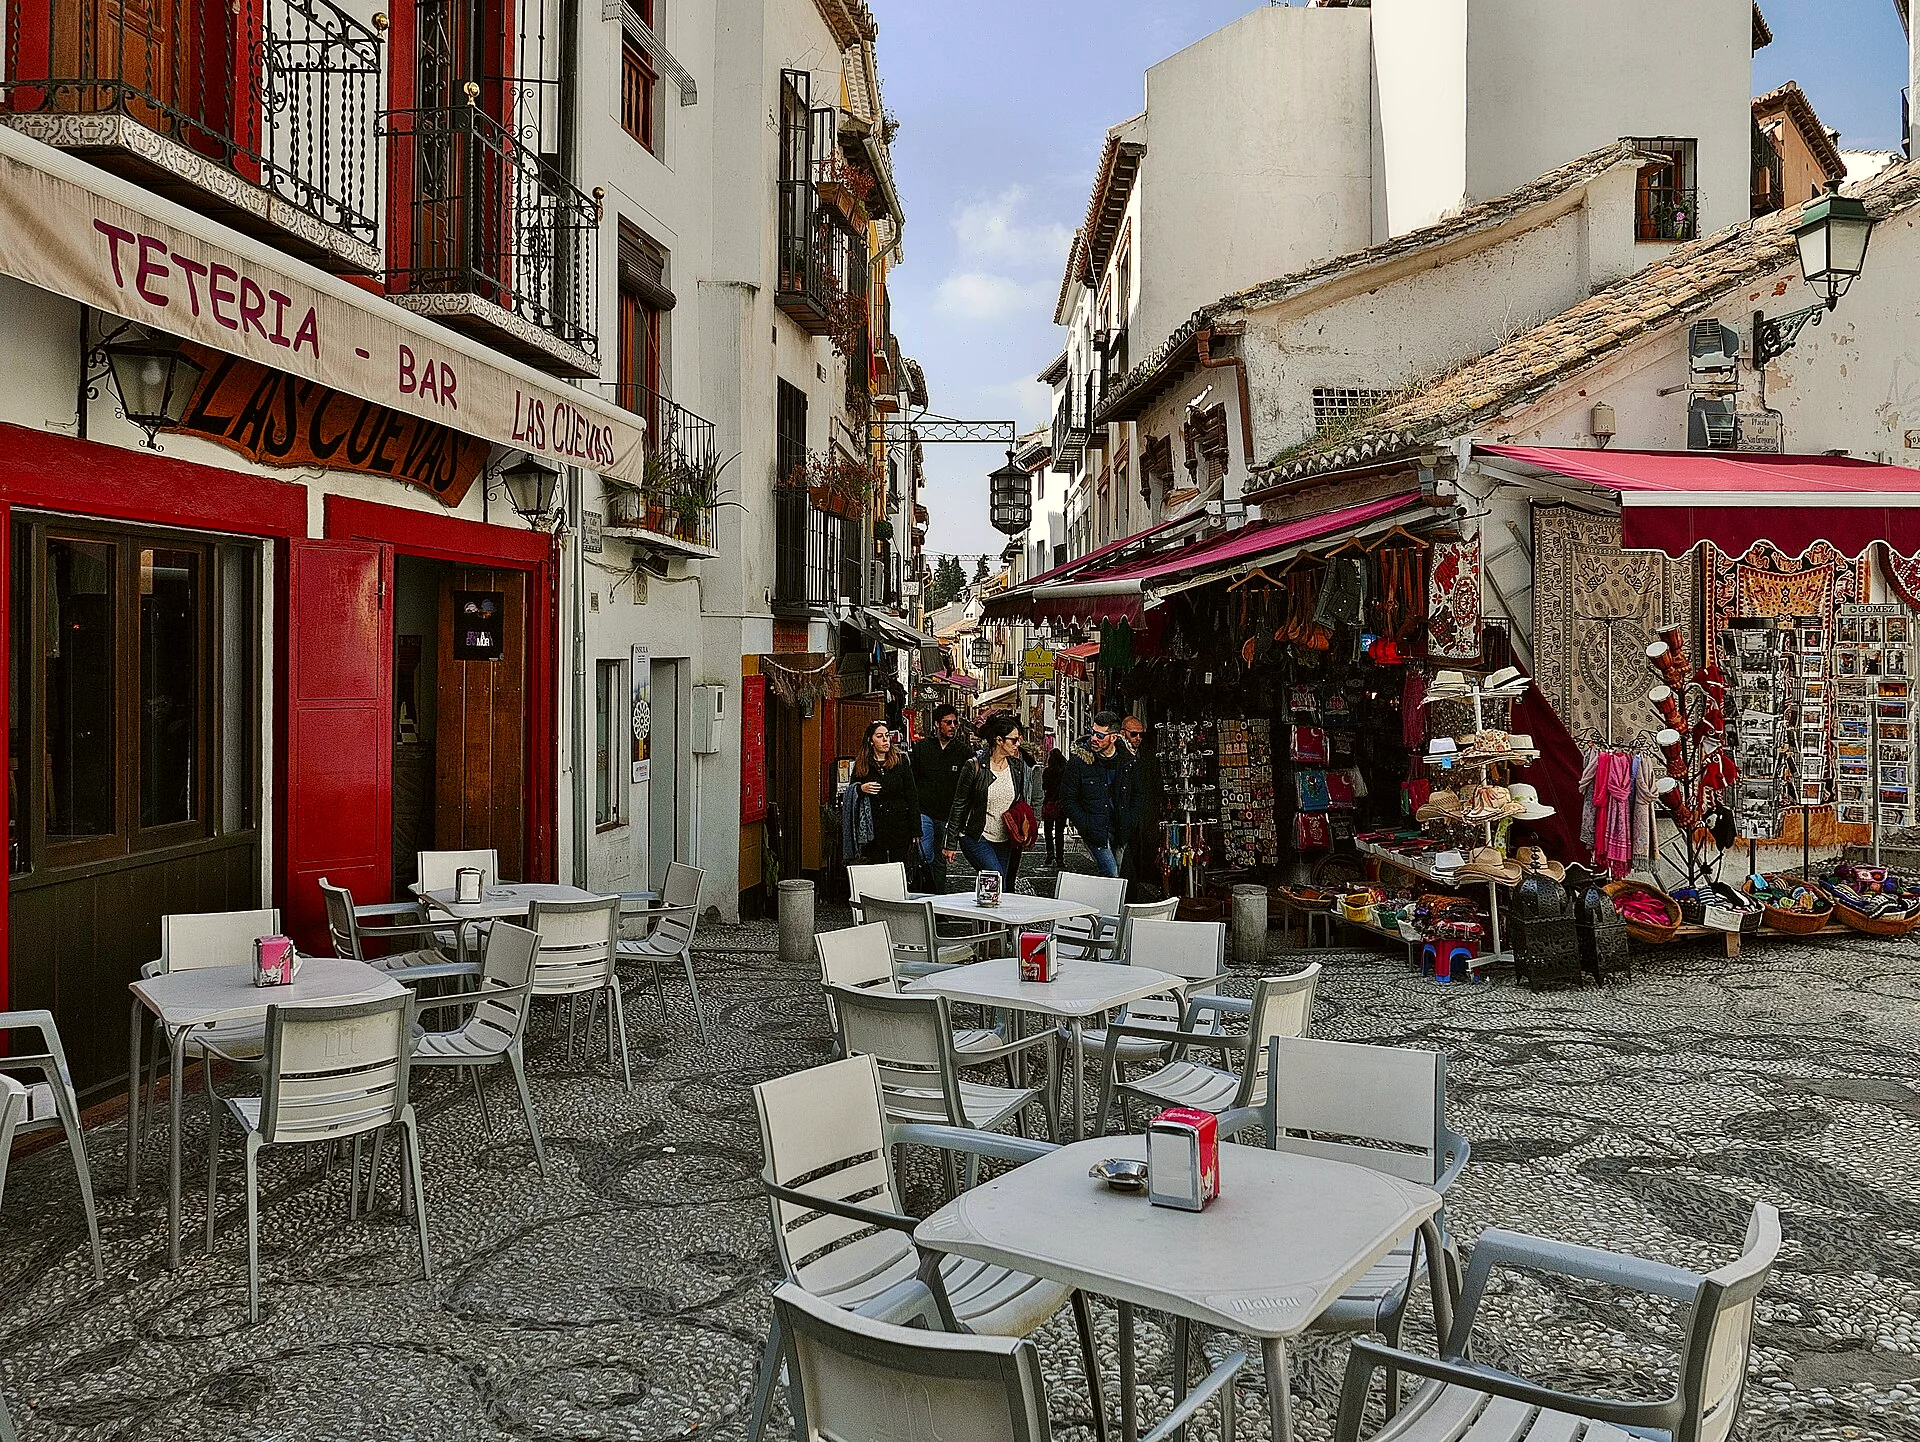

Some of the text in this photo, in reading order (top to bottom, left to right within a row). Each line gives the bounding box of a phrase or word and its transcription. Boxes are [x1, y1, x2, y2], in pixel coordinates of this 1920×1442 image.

[93, 218, 319, 359] TETERIA
[398, 344, 457, 410] BAR
[187, 353, 471, 491] LAS CUEVAS
[511, 390, 614, 466] LAS CUEVAS
[1858, 605, 1895, 613] GOMEZ
[1024, 661, 1054, 669] Arrayane
